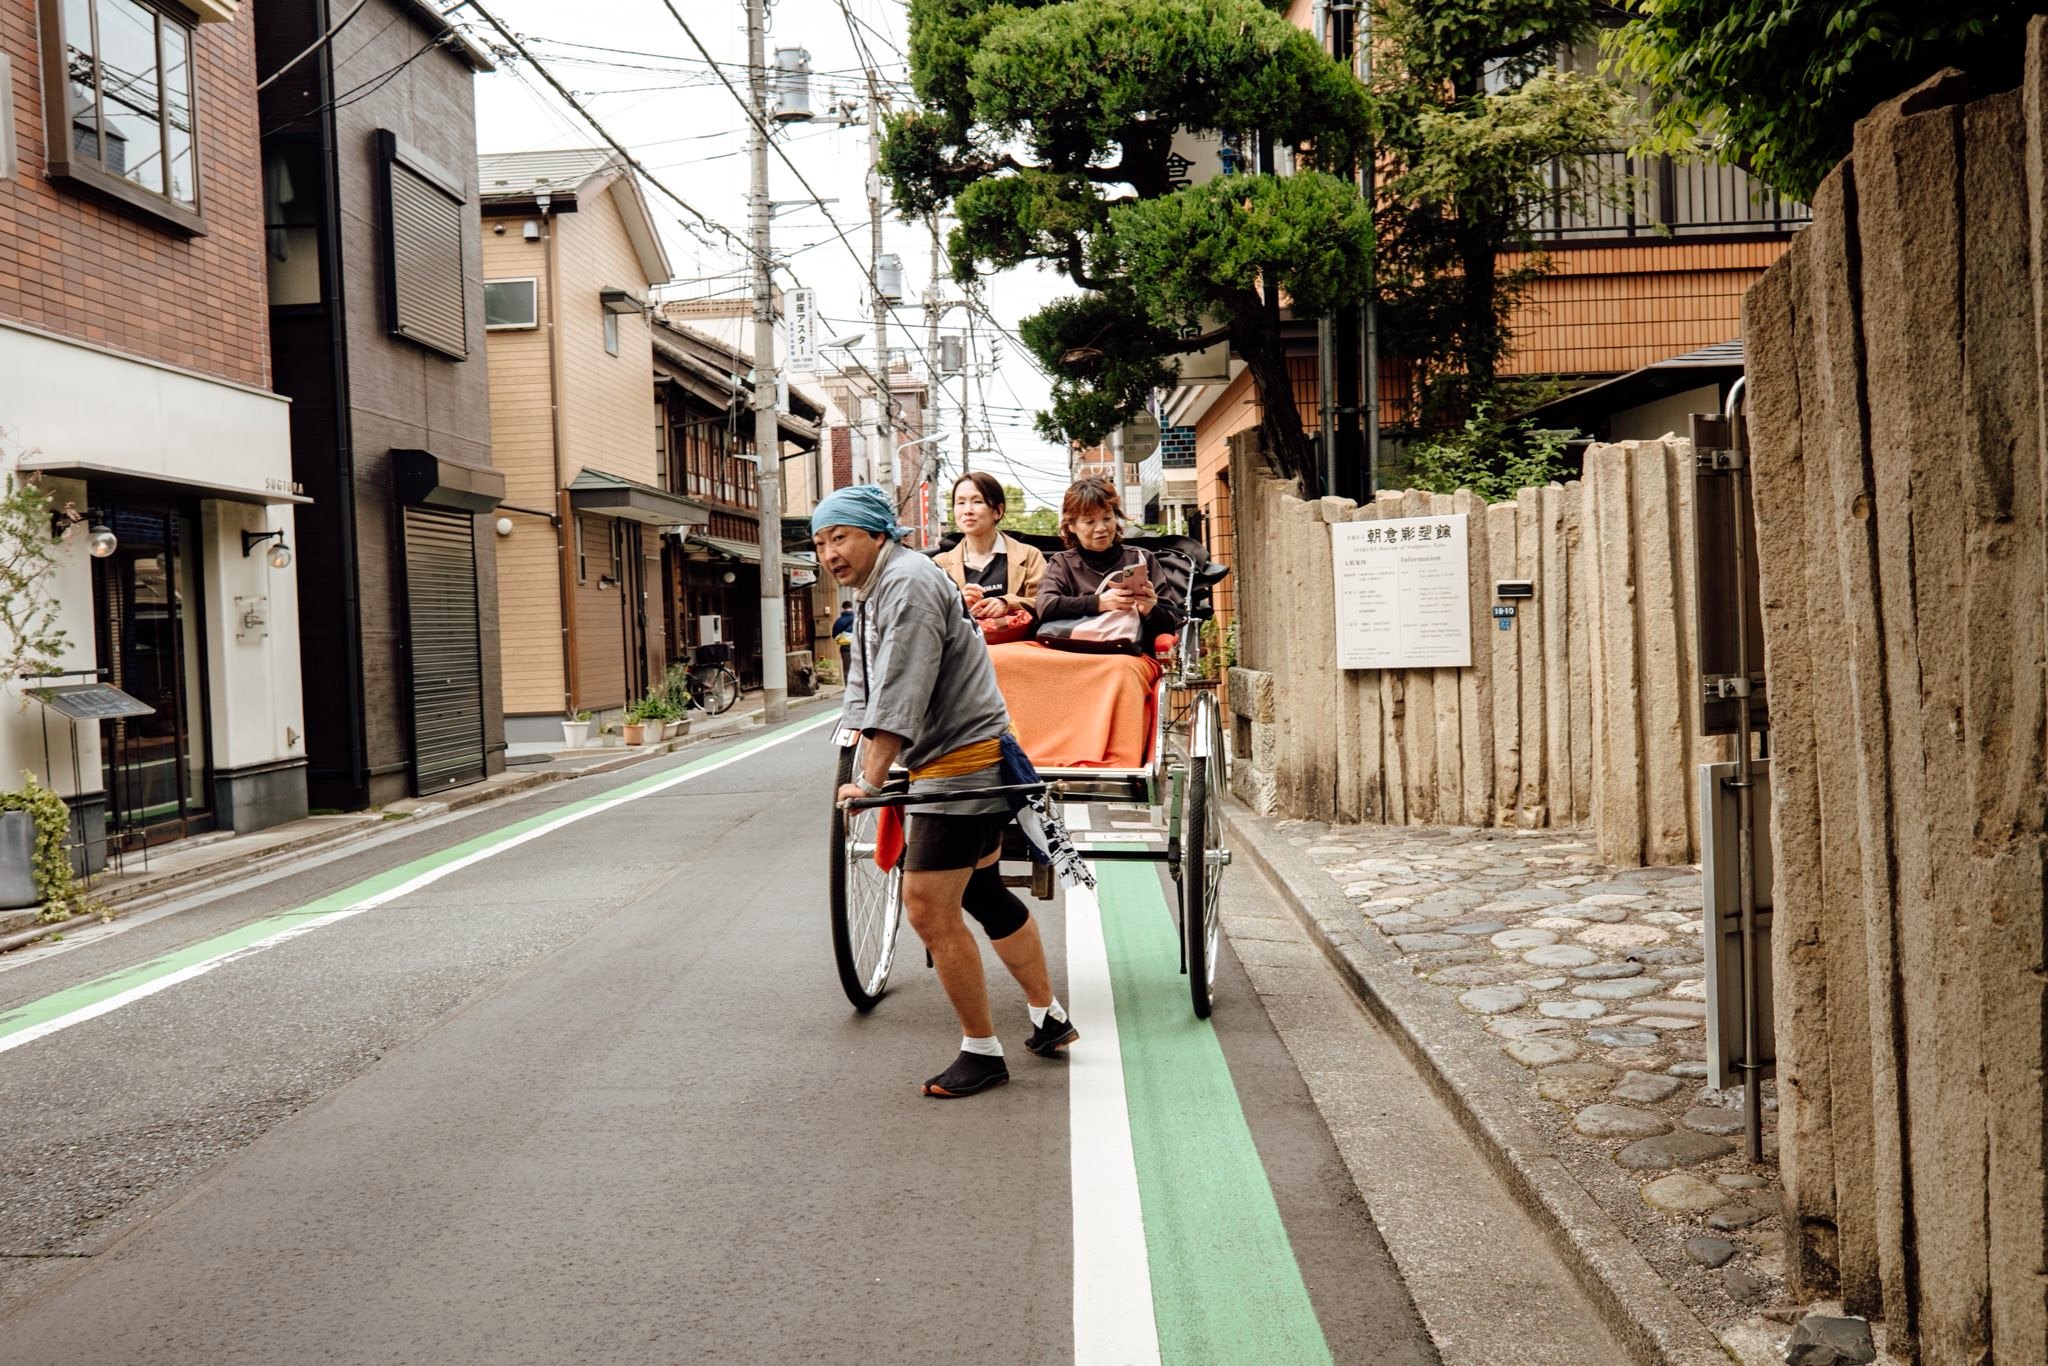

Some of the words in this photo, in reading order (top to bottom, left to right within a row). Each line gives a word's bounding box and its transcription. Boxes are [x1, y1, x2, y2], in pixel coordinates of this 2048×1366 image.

[796, 293, 806, 355] 銀座アスター
[1367, 525, 1452, 544] 朝倉彫塑館
[1400, 556, 1441, 564] Information
[1494, 607, 1514, 615] 18-10
